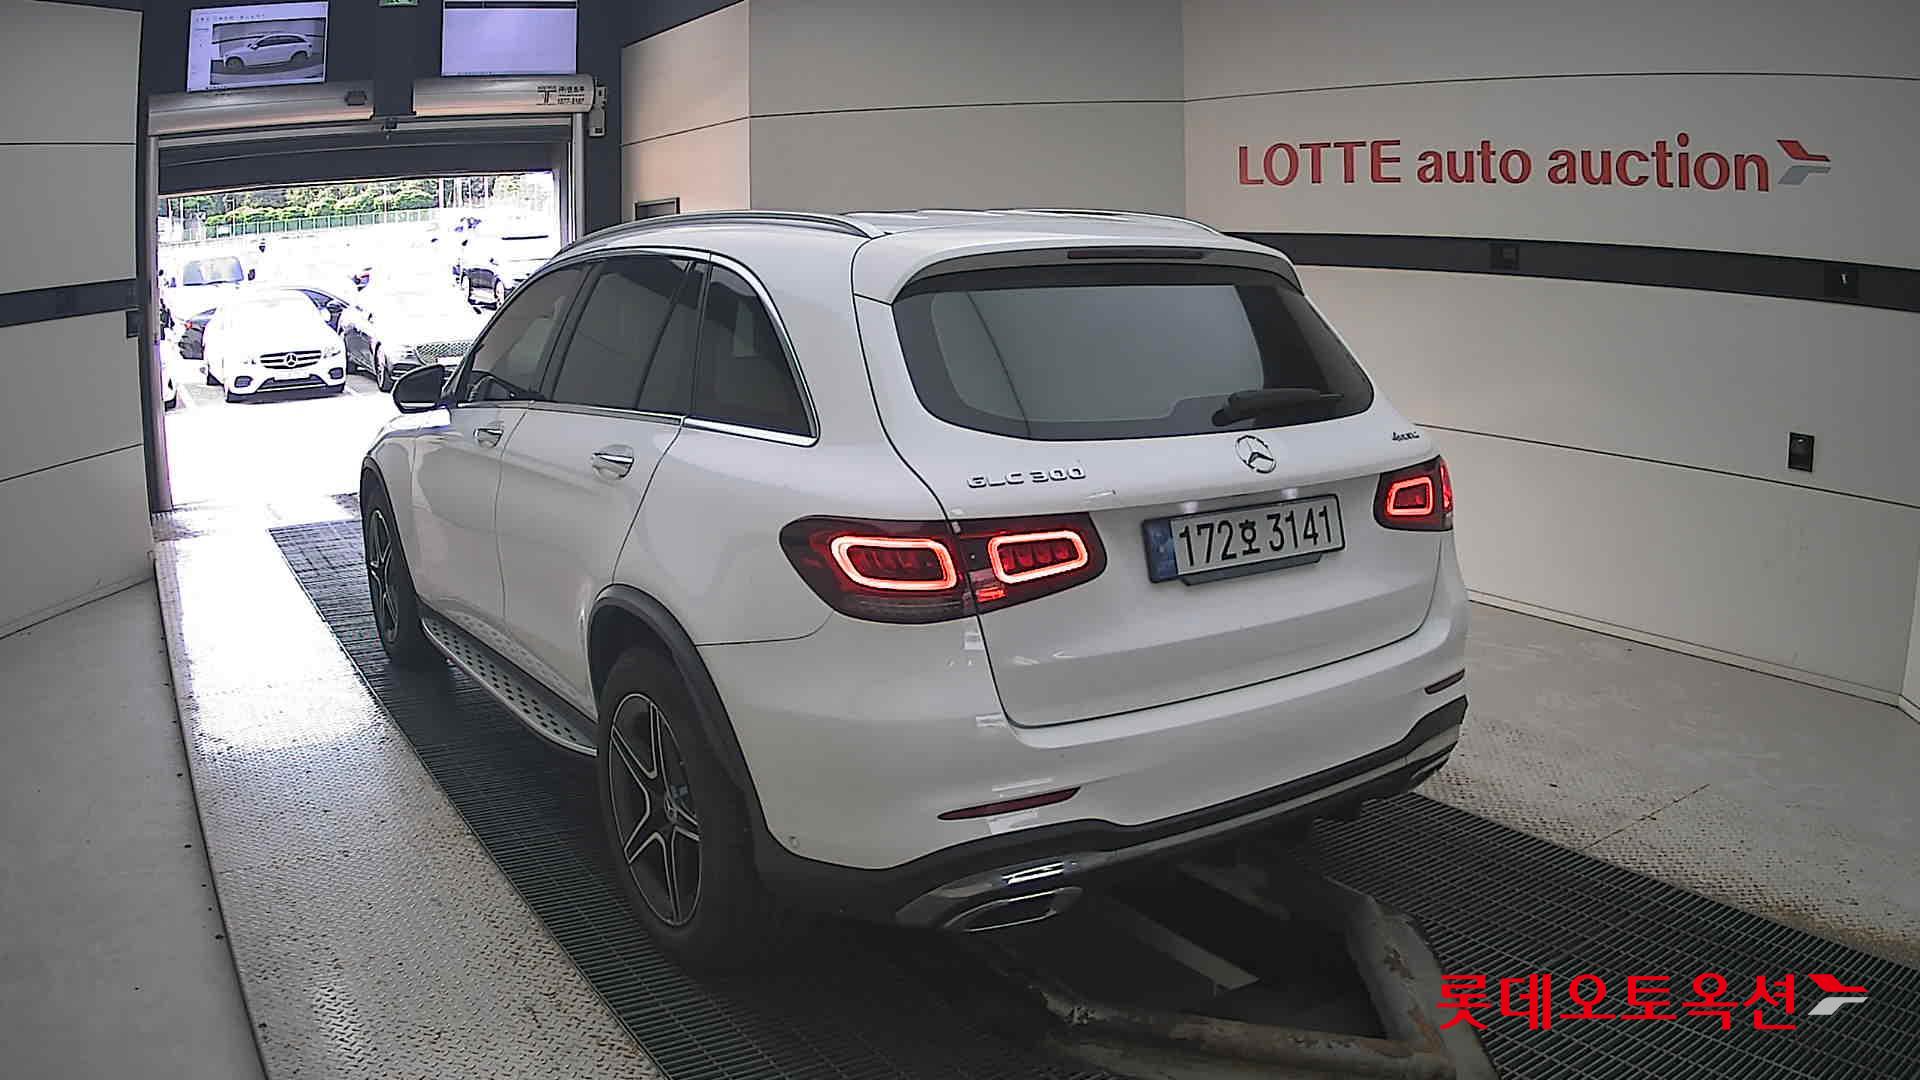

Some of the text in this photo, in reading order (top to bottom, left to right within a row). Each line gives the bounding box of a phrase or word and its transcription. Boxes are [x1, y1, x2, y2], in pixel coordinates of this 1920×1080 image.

[1238, 132, 1770, 192] LOTTE auto auction
[967, 465, 1086, 488] GLC 300
[1178, 505, 1332, 567] 172호 3141
